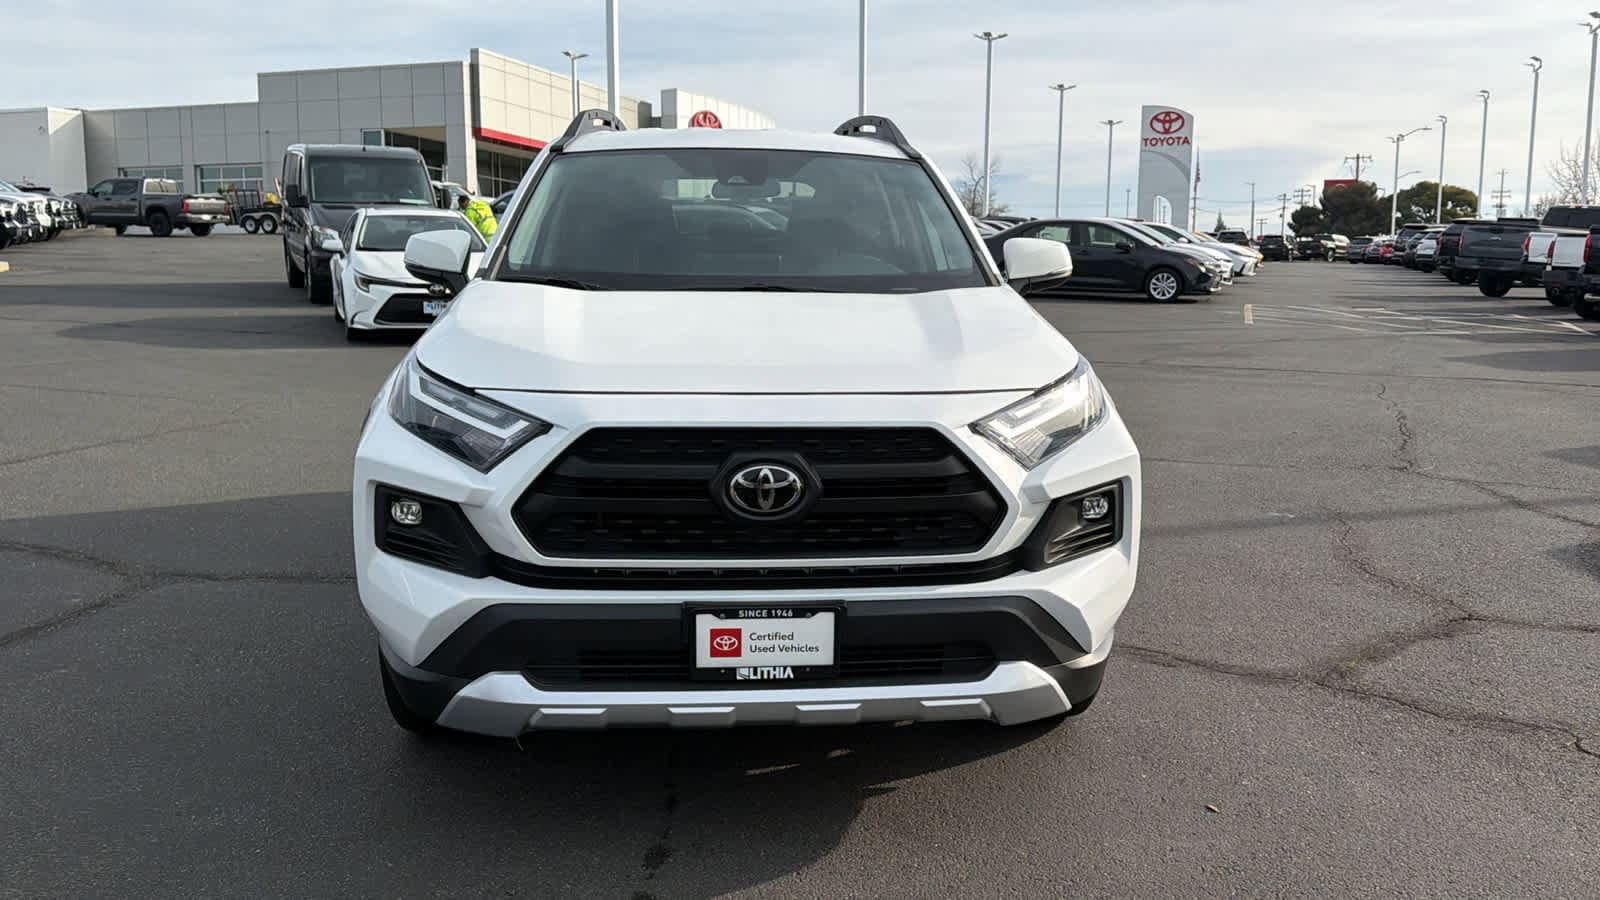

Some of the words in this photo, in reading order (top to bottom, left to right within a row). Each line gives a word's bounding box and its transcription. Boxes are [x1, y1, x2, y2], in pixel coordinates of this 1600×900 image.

[1143, 136, 1190, 147] TOYOTA
[738, 610, 768, 618] SINCE
[771, 609, 794, 617] 1946
[749, 631, 794, 641] Certified
[749, 644, 775, 653] Used
[777, 643, 819, 653] Vehicles
[749, 666, 794, 679] LITHIA
